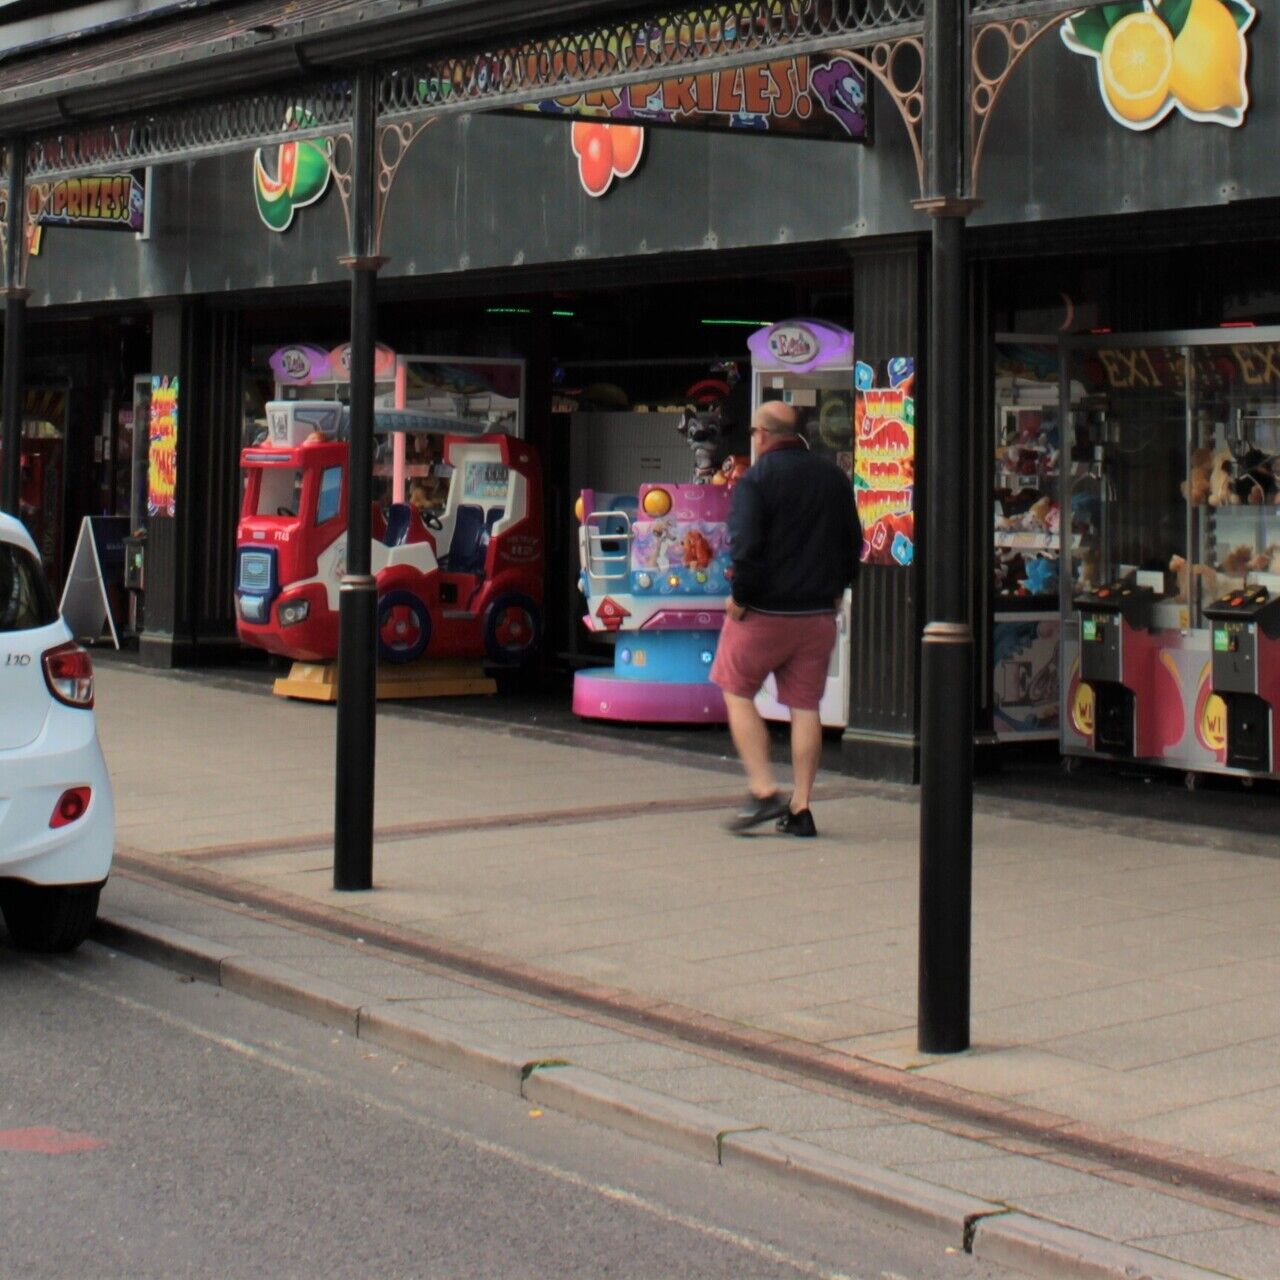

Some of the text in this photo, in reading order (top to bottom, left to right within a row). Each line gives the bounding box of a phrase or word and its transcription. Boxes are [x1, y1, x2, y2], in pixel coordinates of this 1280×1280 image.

[54, 175, 132, 221] PRIZES!
[1077, 701, 1093, 719] WI
[1205, 715, 1222, 733] WI
